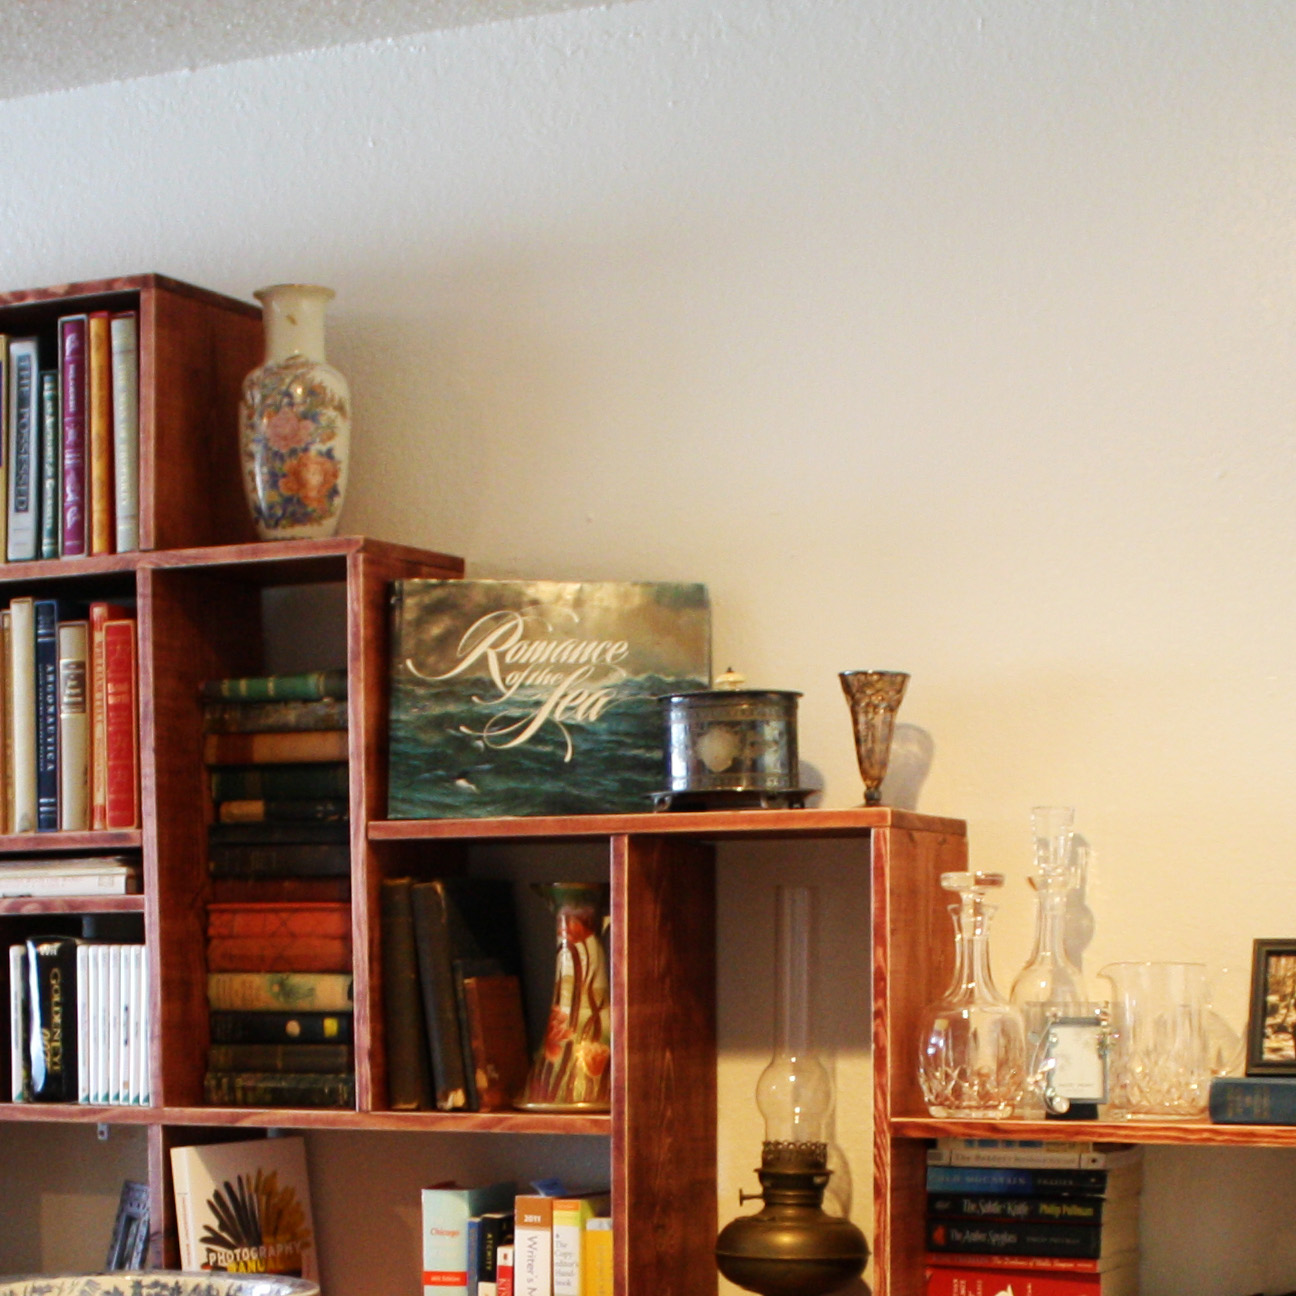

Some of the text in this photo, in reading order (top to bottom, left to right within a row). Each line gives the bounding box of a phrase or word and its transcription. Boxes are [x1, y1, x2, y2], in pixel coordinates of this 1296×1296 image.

[406, 608, 630, 704] Romance
[505, 665, 564, 688] of the
[45, 664, 56, 772] ARGONAUTICA
[523, 1213, 542, 1223] 2011
[207, 1241, 302, 1266] PHOTOGRAPHY
[525, 1235, 538, 1283] Writer's
